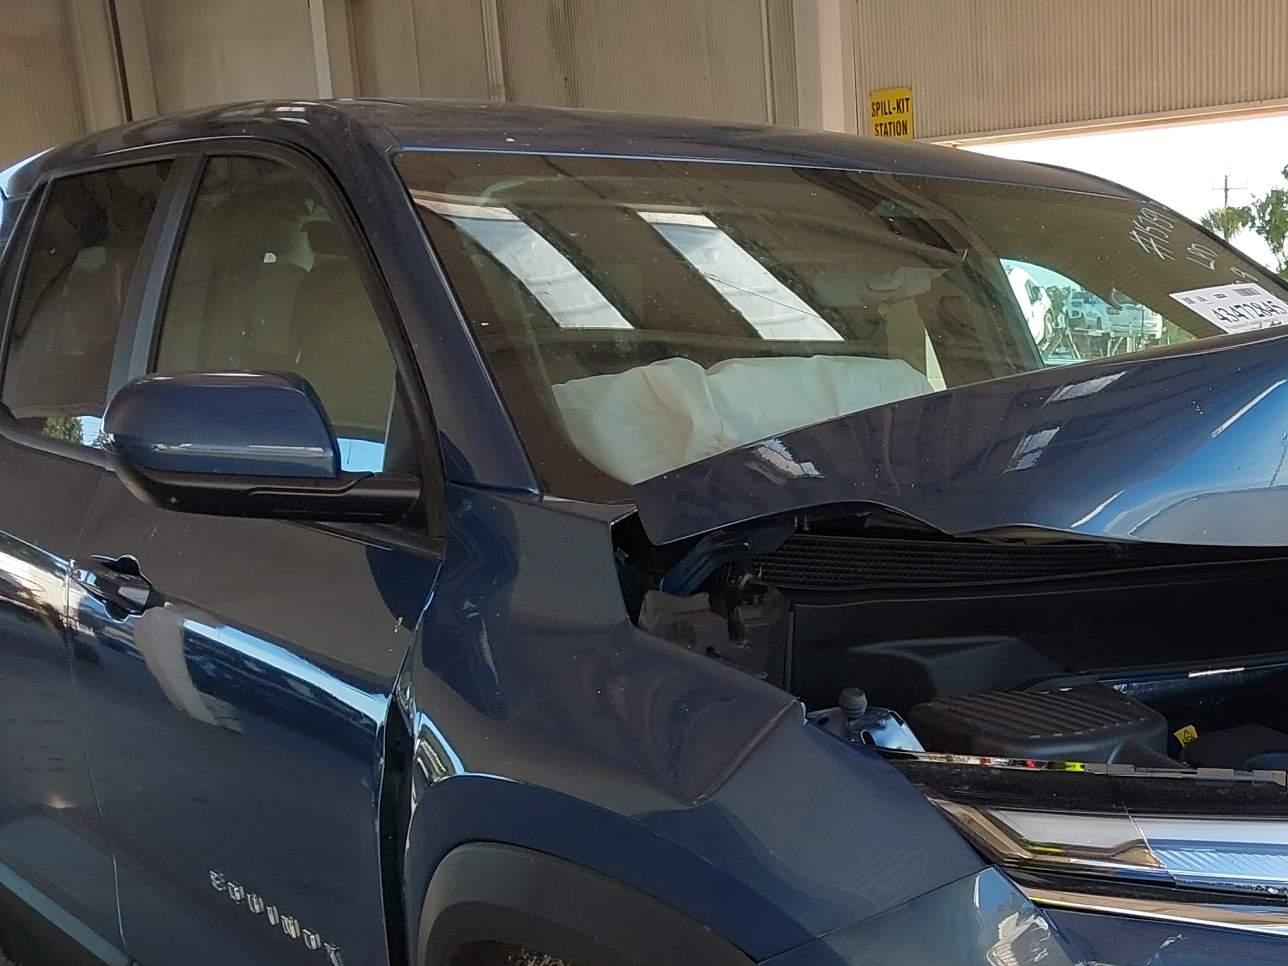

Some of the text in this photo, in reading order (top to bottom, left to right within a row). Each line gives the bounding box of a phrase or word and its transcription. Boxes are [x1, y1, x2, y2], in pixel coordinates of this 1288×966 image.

[871, 98, 910, 117] SPILL-KIT
[874, 120, 908, 137] STATION
[1211, 301, 1288, 323] 43472845
